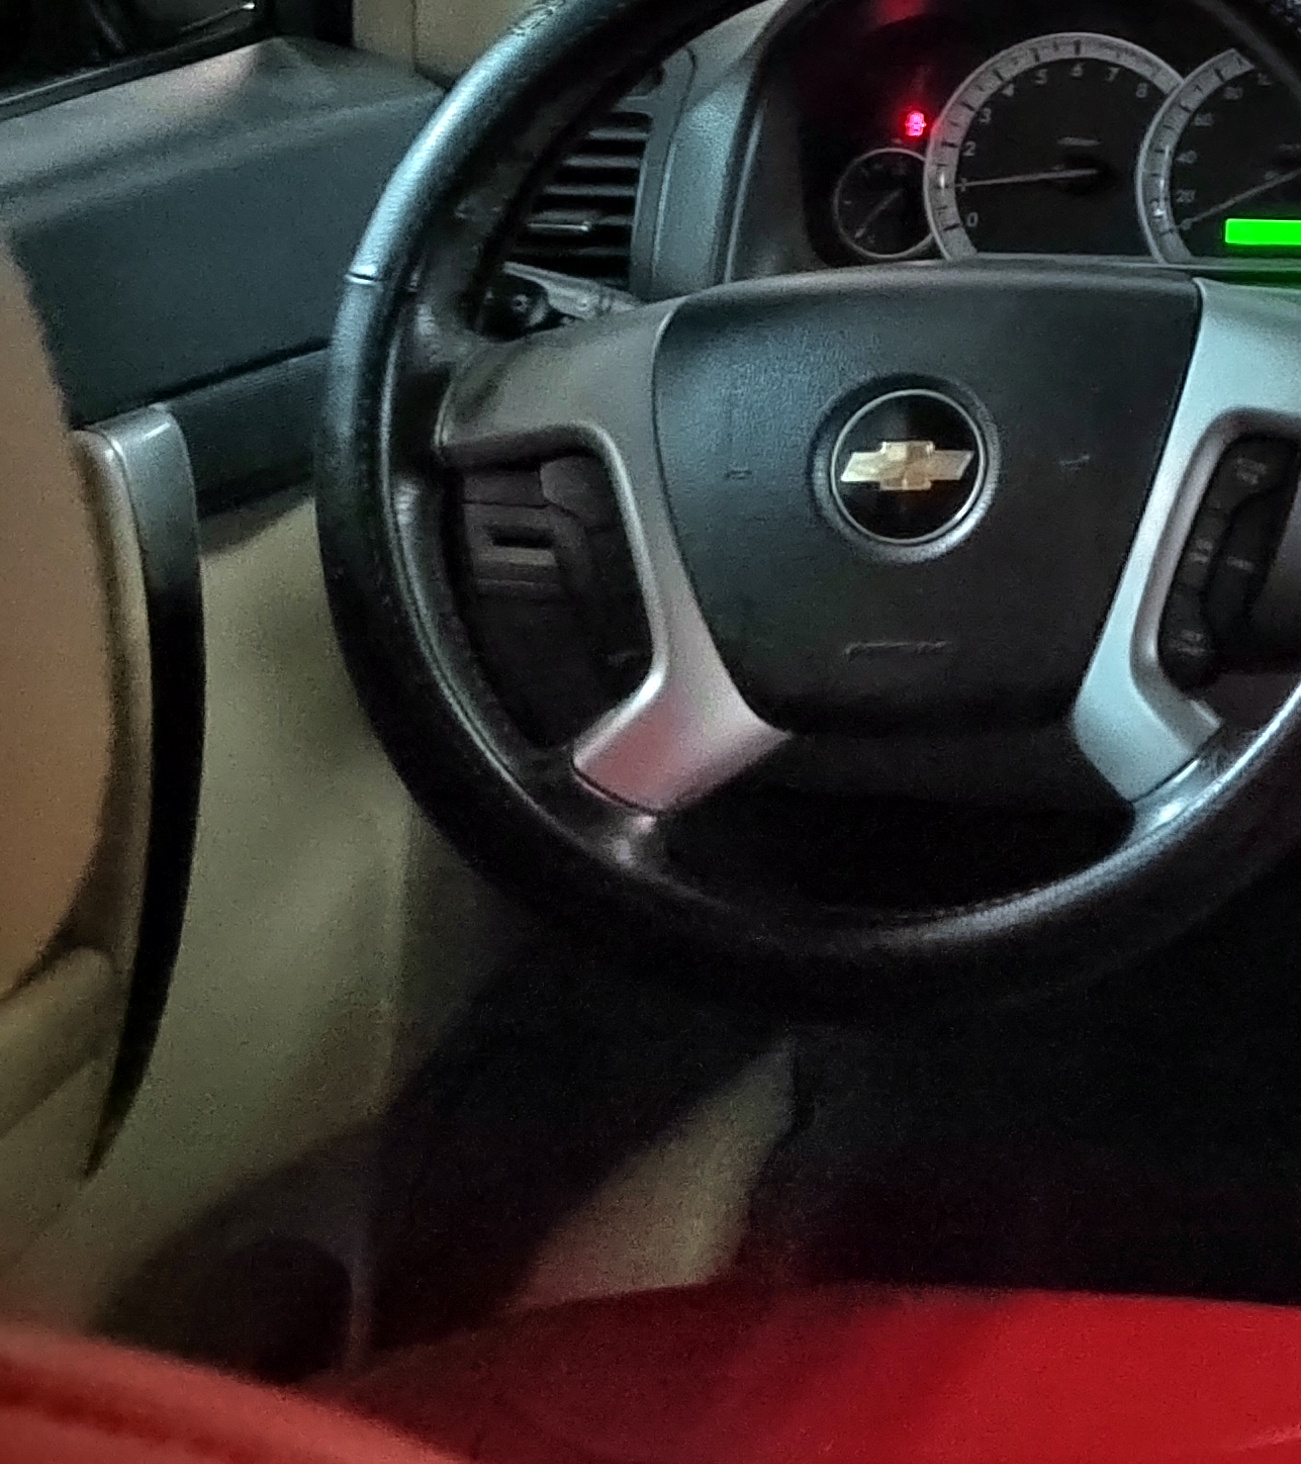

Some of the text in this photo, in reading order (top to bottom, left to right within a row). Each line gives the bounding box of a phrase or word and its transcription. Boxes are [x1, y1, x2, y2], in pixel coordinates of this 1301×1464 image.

[979, 108, 992, 124] 3
[963, 141, 976, 156] 2
[966, 212, 979, 228] 0
